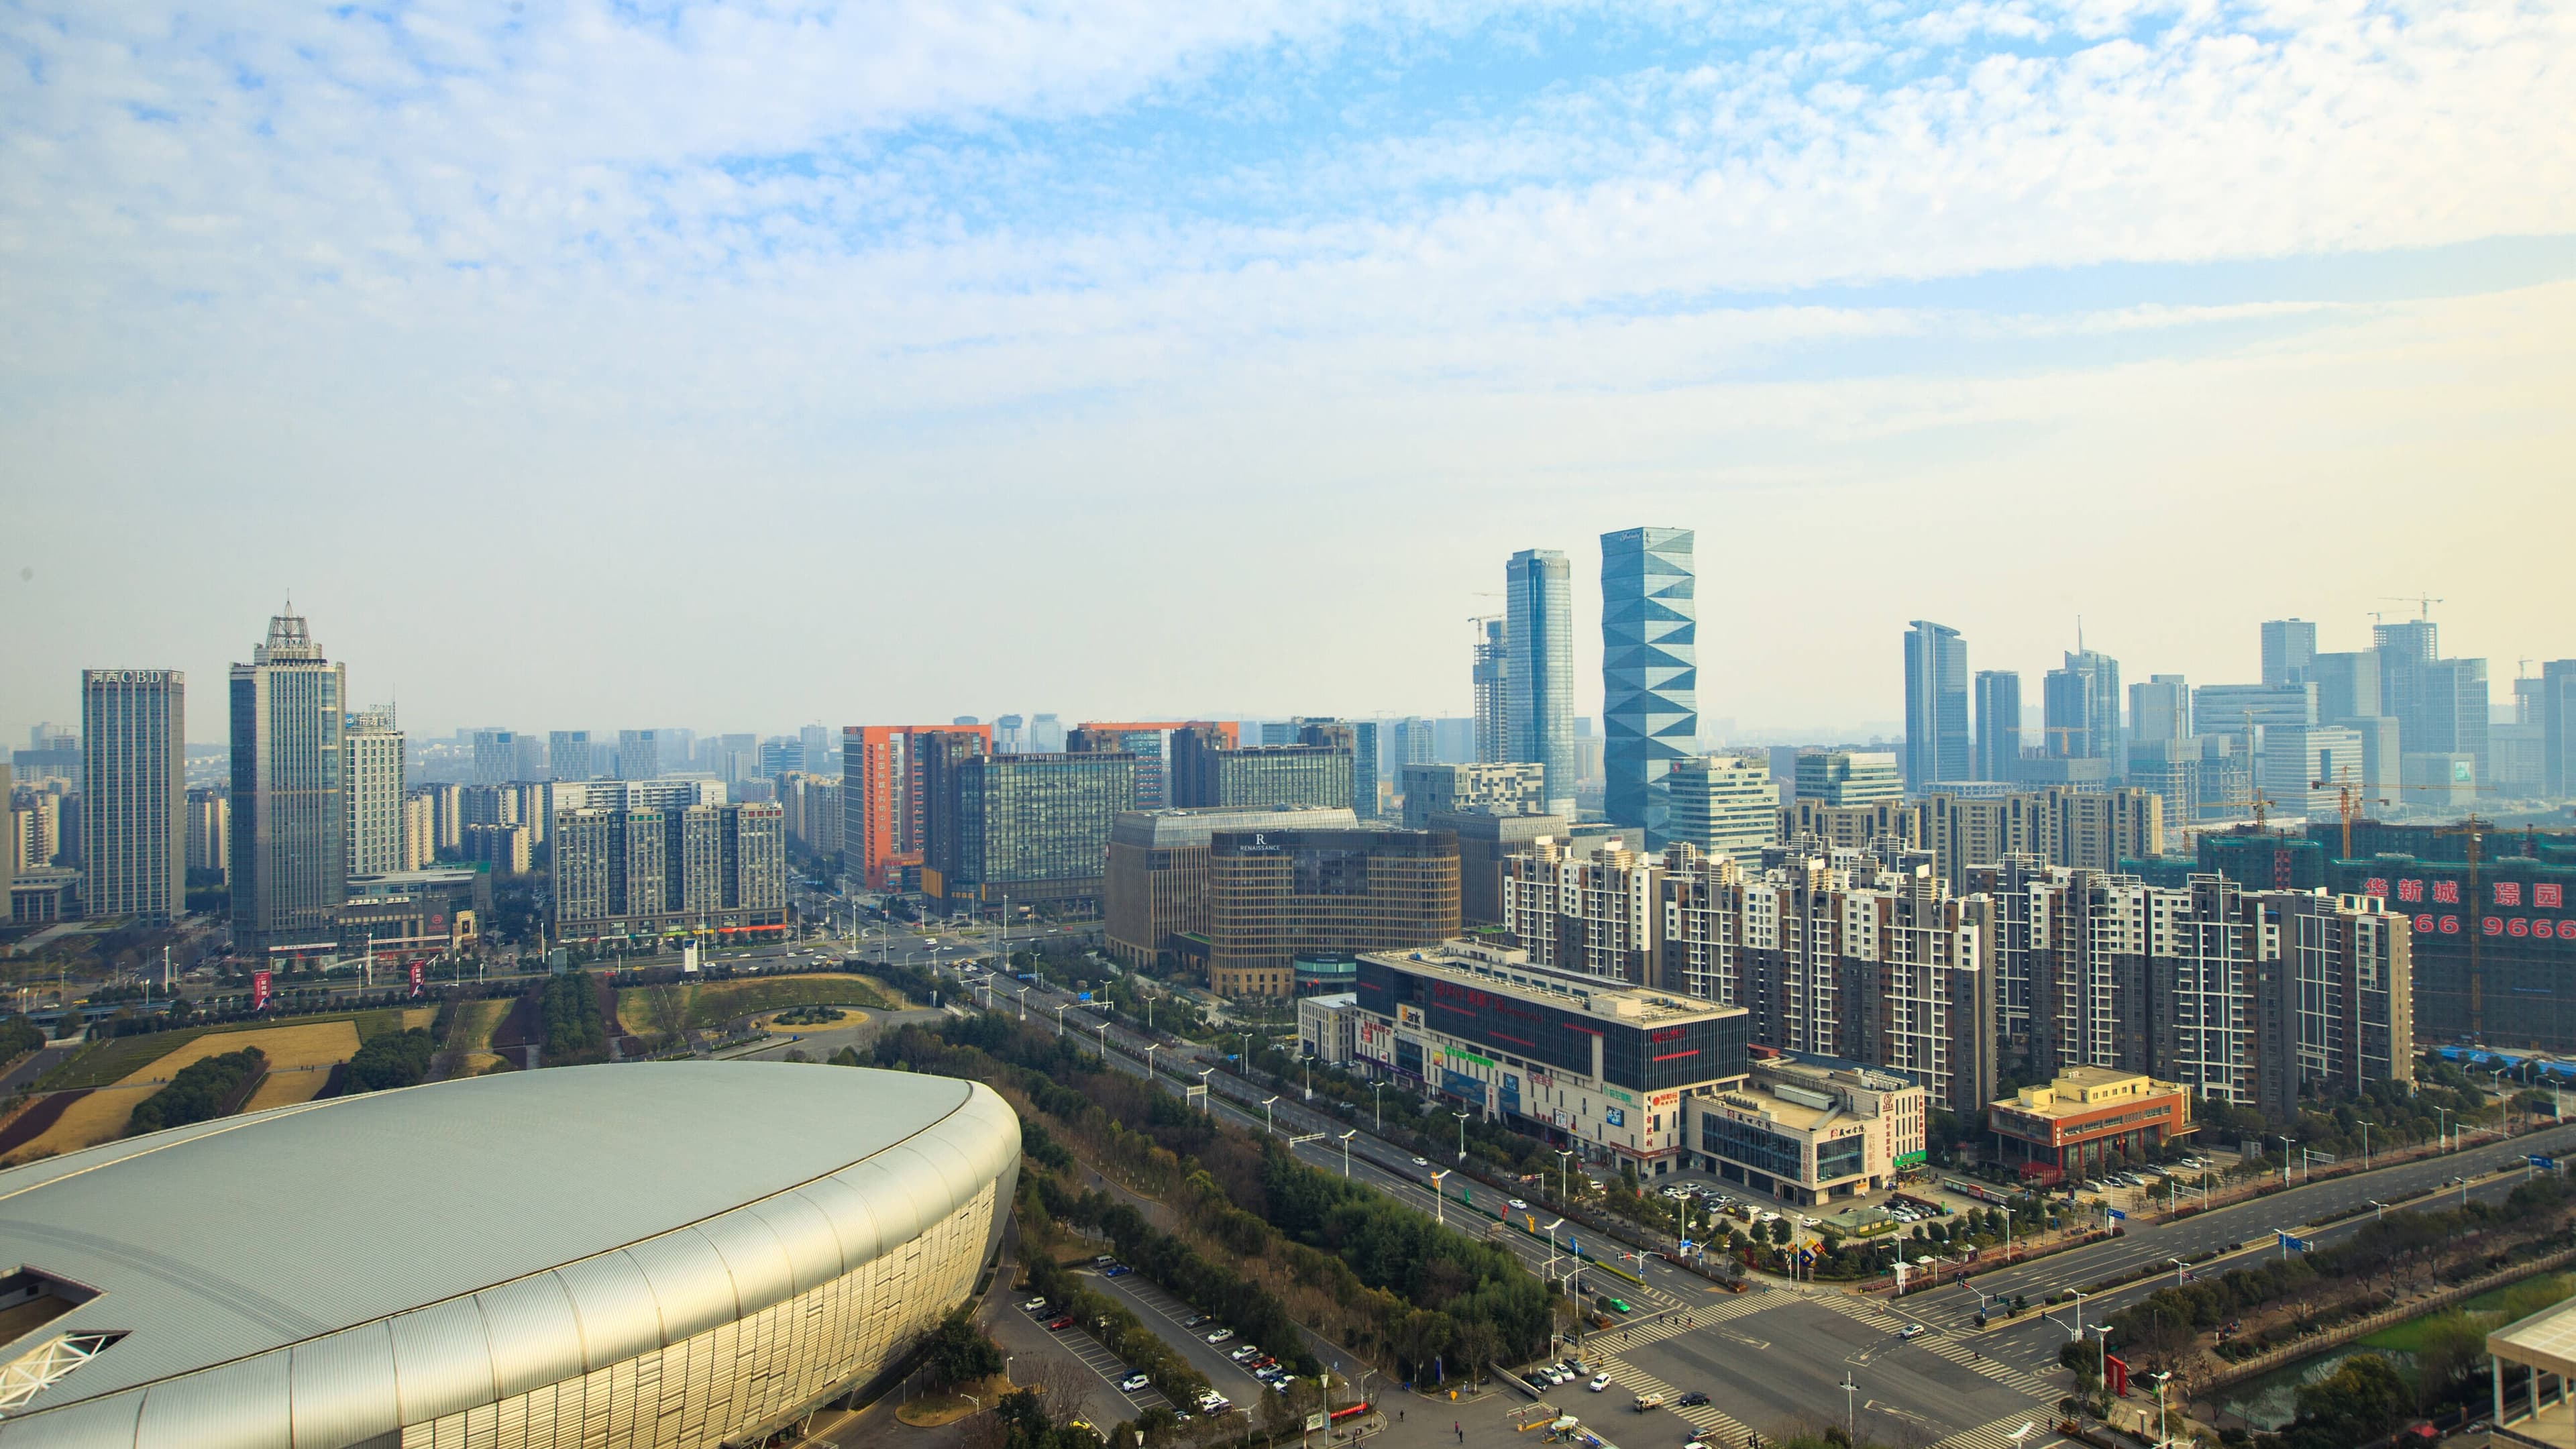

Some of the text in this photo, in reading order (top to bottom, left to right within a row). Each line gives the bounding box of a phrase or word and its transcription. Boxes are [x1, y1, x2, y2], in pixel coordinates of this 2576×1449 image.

[1256, 834, 1267, 845] R
[2365, 878, 2562, 908] 华新城 璟园
